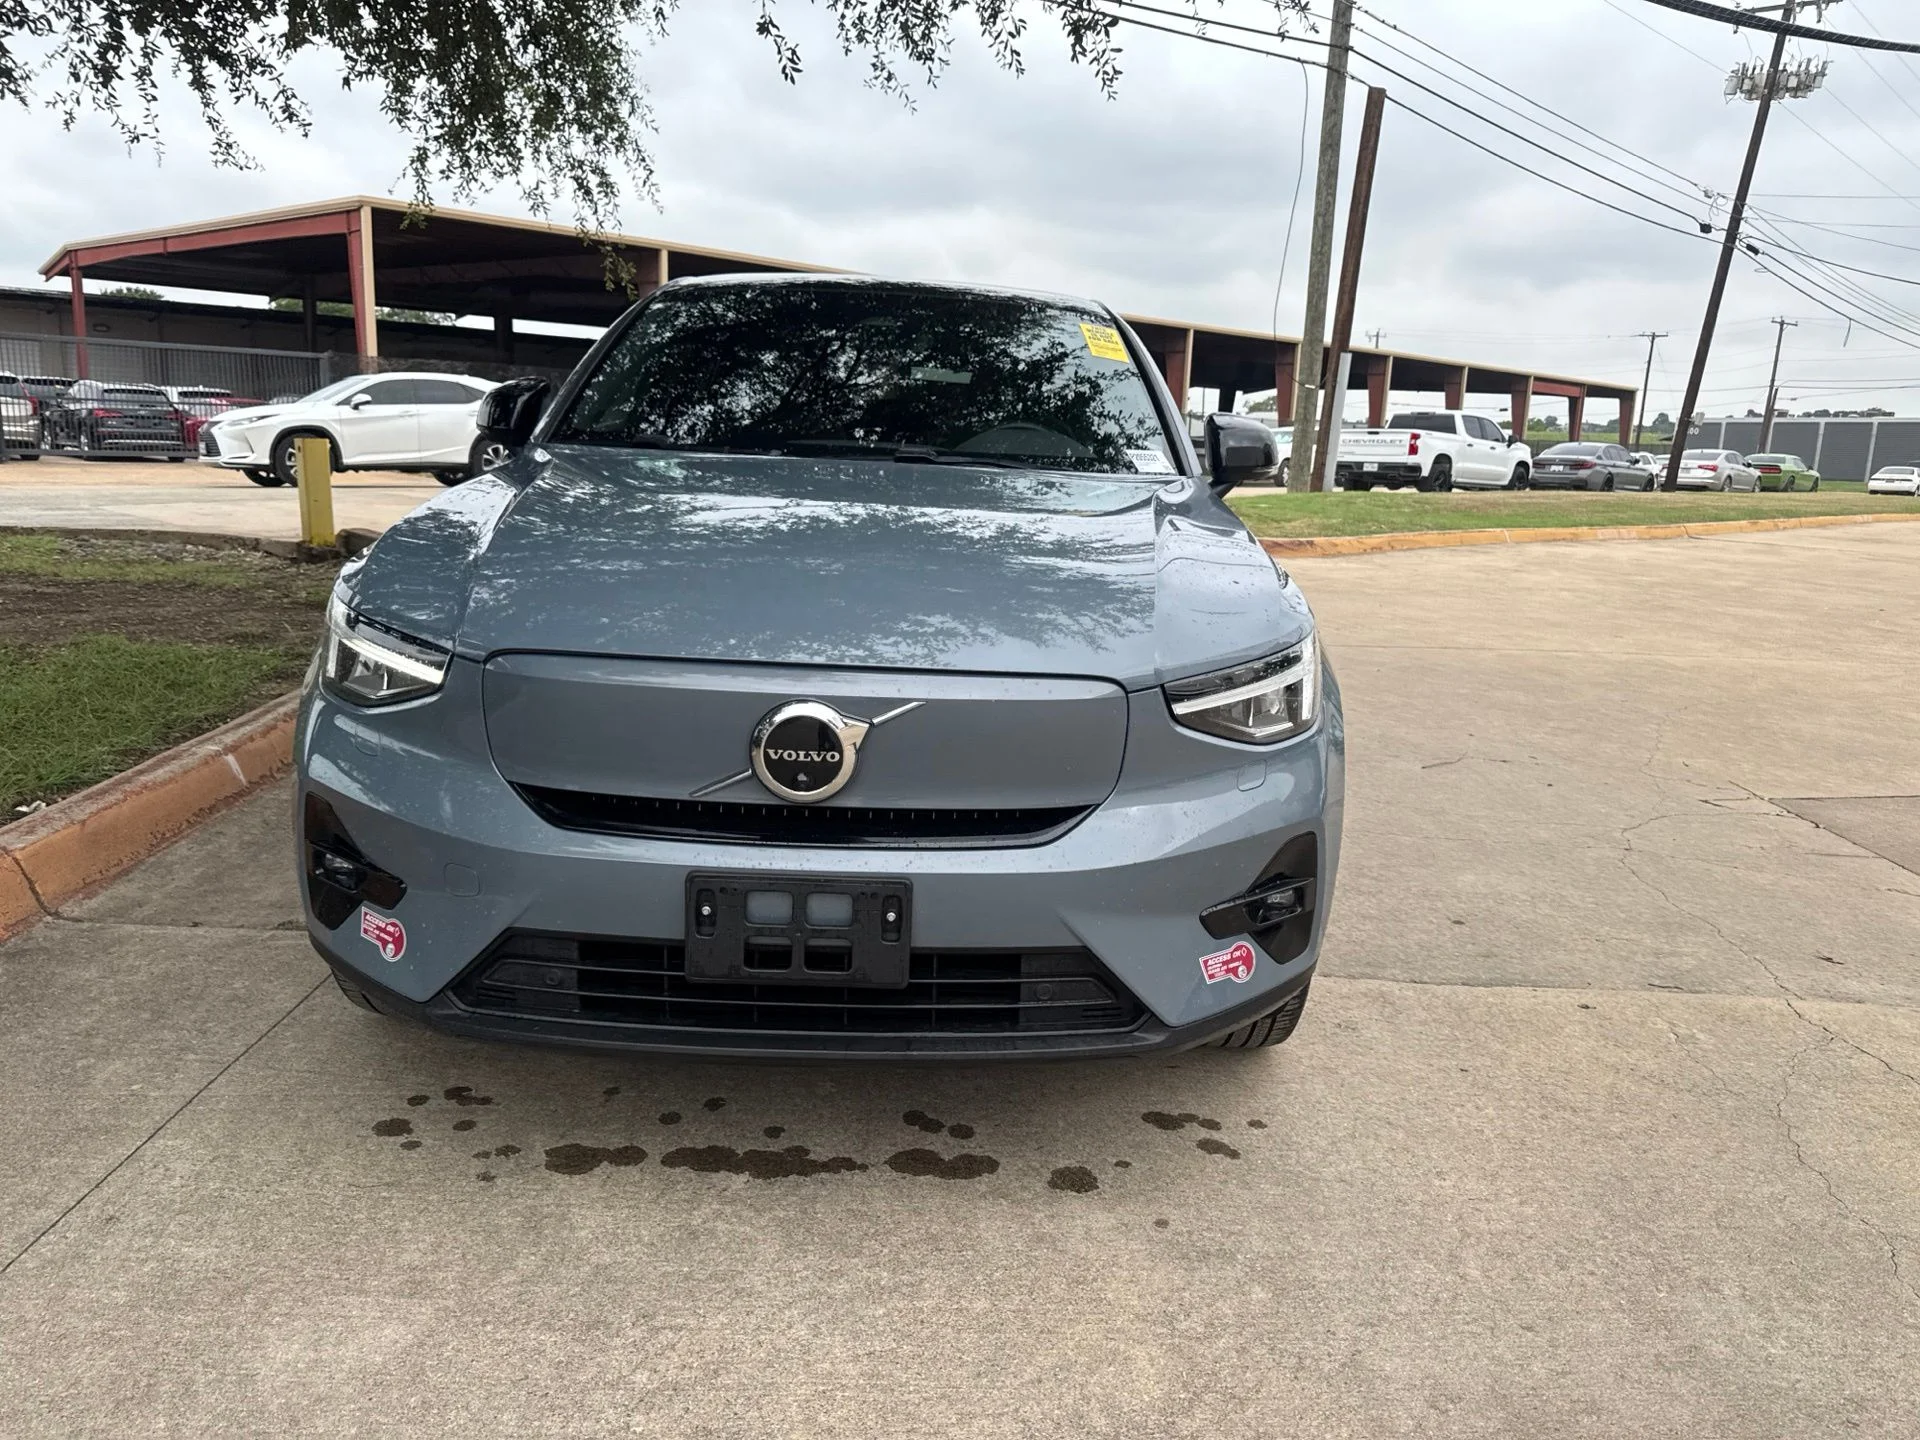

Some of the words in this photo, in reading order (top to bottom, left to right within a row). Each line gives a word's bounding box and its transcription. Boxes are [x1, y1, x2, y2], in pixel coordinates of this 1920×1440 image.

[1688, 427, 1699, 435] 00
[766, 748, 840, 762] VOLVO
[1207, 952, 1232, 966] ACCESS
[1232, 950, 1241, 958] OK
